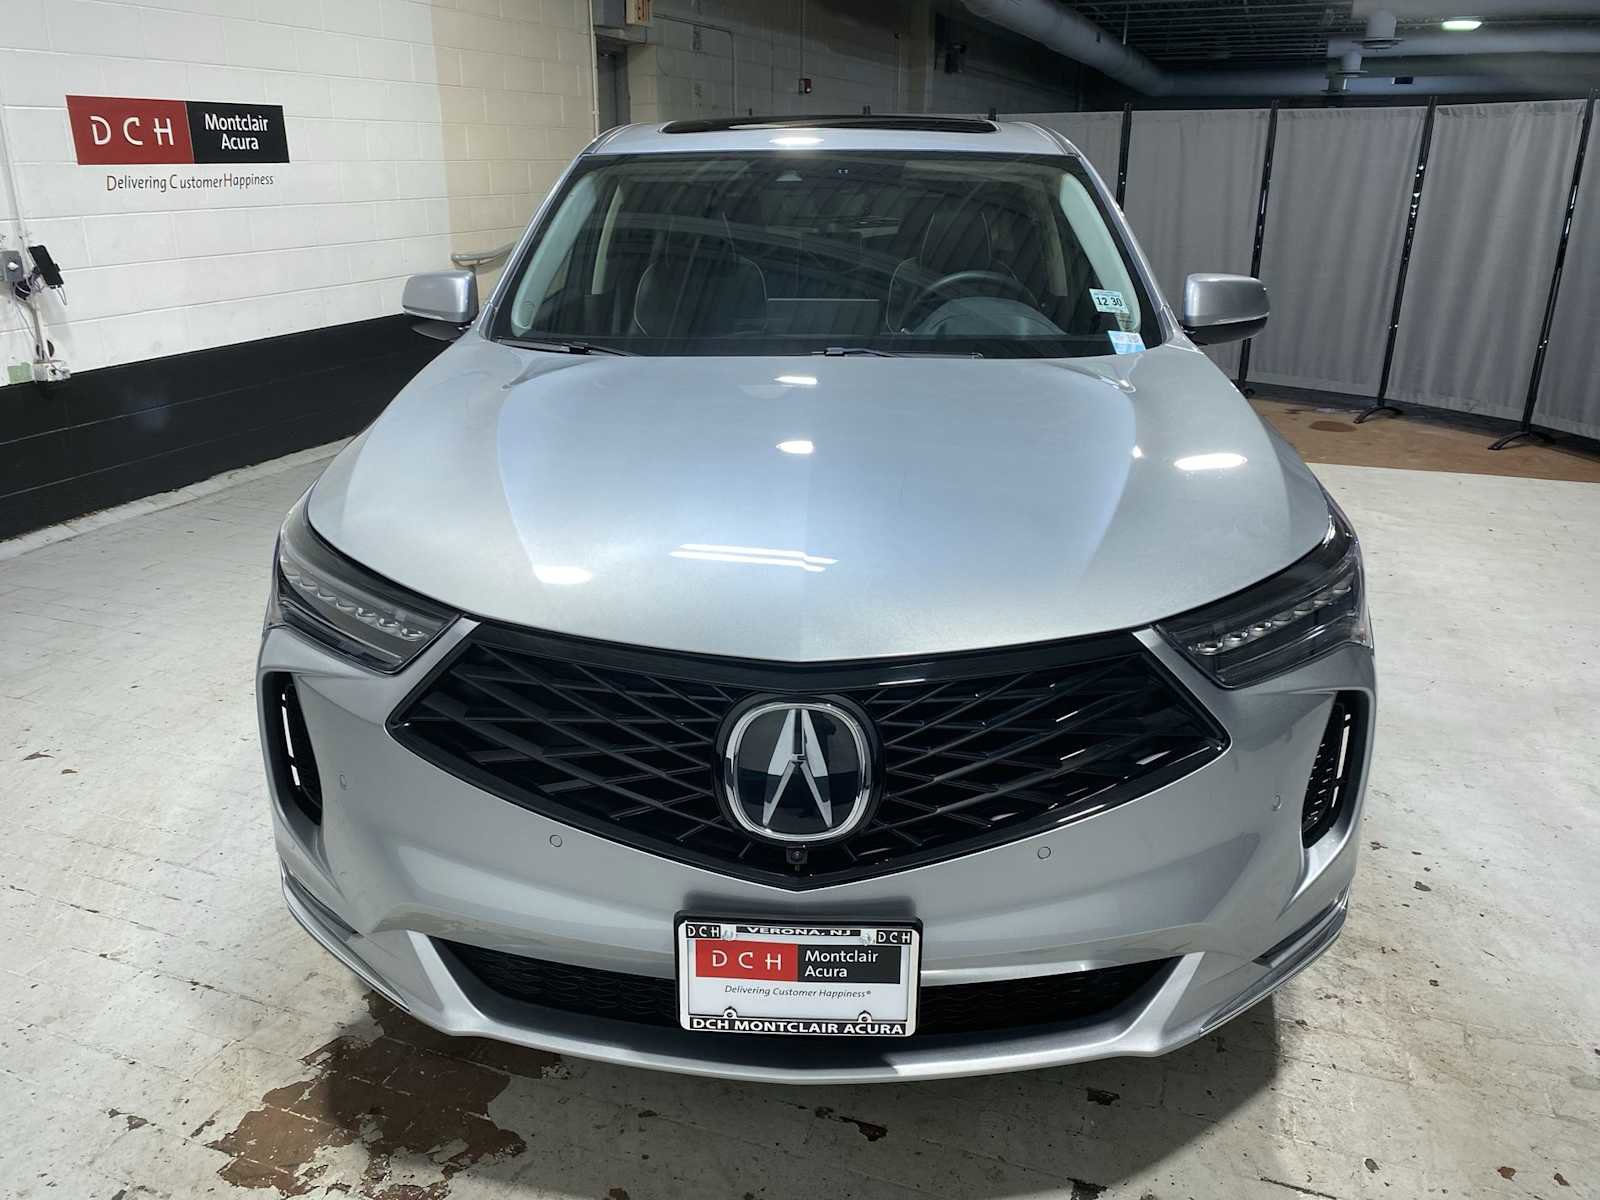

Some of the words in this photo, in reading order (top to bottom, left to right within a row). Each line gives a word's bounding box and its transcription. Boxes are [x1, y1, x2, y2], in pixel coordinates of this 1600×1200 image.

[204, 113, 269, 132] Montclair
[90, 115, 175, 146] DCH
[221, 134, 260, 150] Acura
[106, 175, 167, 192] Delivering
[687, 925, 720, 938] DCH
[830, 928, 851, 936] NJ
[878, 931, 911, 944] DCH
[712, 949, 782, 971] DCH
[804, 949, 879, 963] Montclair
[804, 965, 848, 978] Acura
[724, 984, 771, 997] Delivering
[772, 987, 817, 997] Customer
[692, 1018, 729, 1030] DCH
[734, 1020, 839, 1034] MONTCLAIR
[843, 1023, 904, 1035] ACURA
